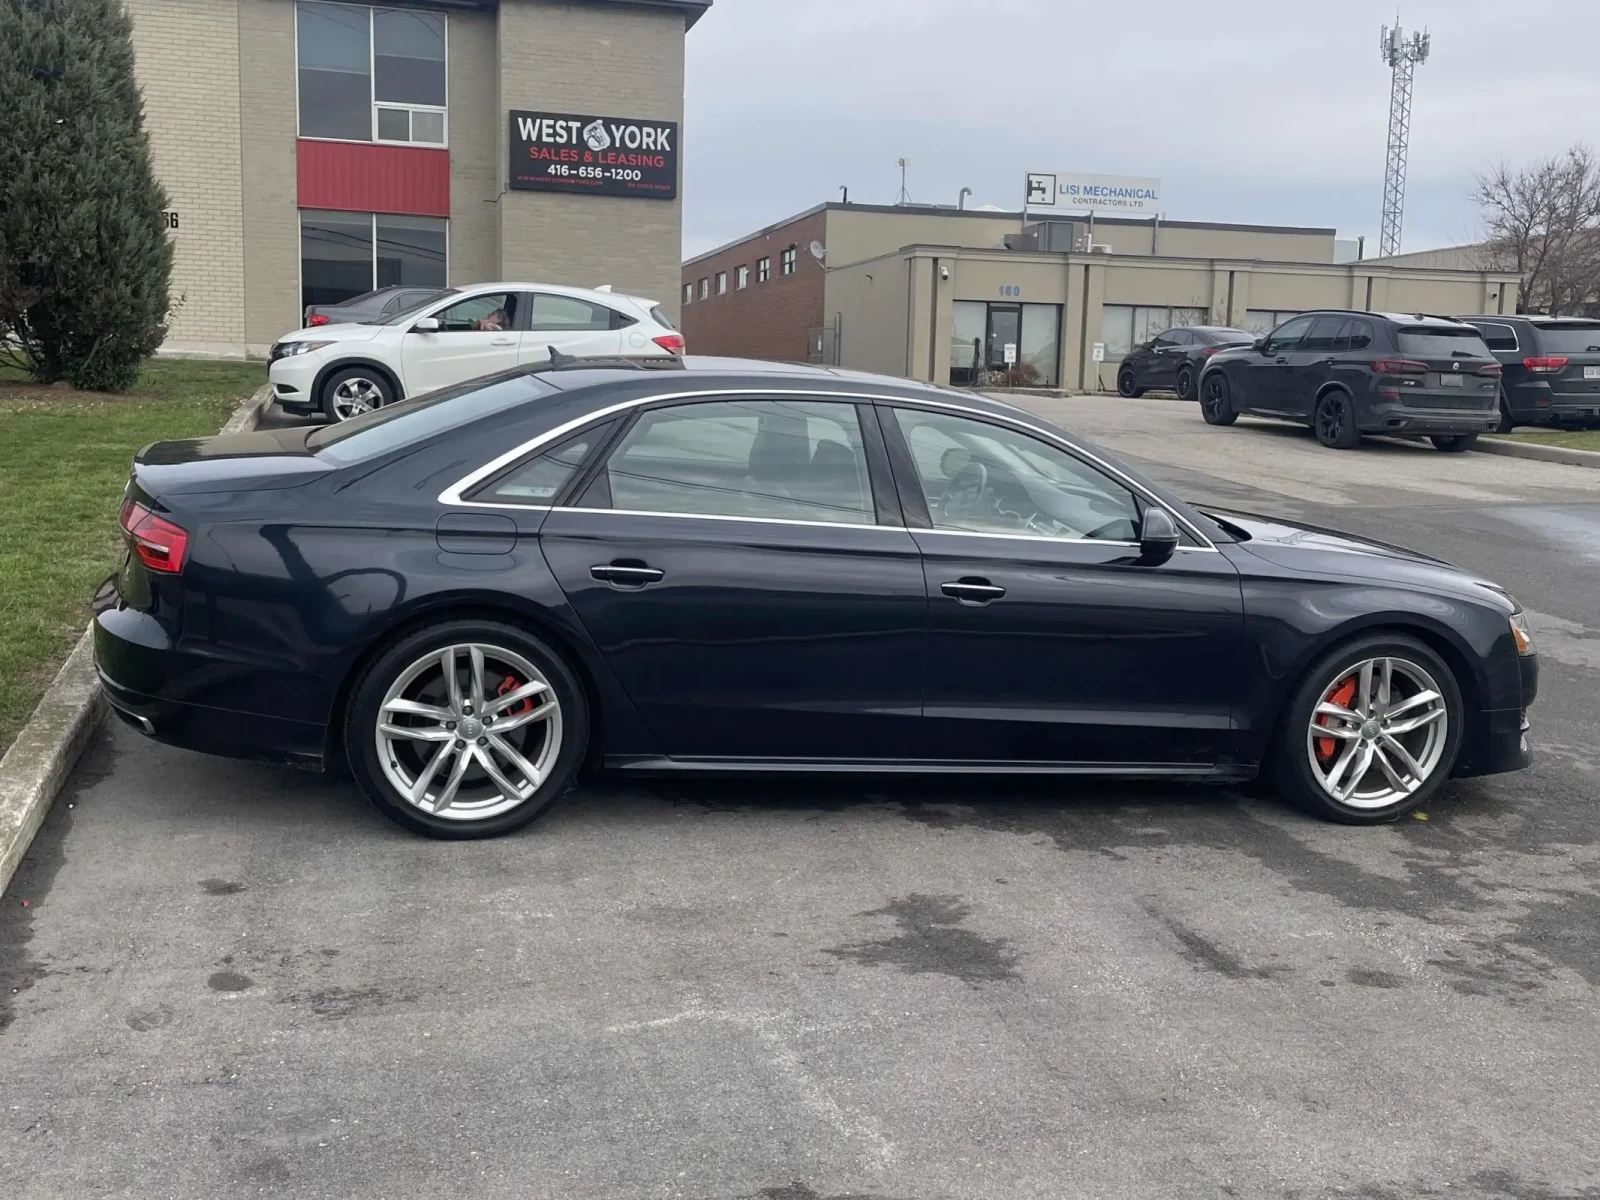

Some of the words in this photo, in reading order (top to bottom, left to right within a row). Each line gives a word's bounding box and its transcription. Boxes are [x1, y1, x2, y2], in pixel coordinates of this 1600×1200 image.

[517, 117, 581, 145] WEST
[610, 124, 671, 151] YORK
[529, 147, 579, 162] SALES
[583, 151, 593, 163] &
[598, 153, 664, 168] LEASING
[547, 164, 641, 181] 416-656-1200
[1059, 184, 1080, 196] LISI
[1083, 185, 1158, 200] MECHANICAL
[1072, 197, 1127, 207] CONTRACTORS
[1129, 200, 1144, 208] LTD
[999, 285, 1020, 296] 160
